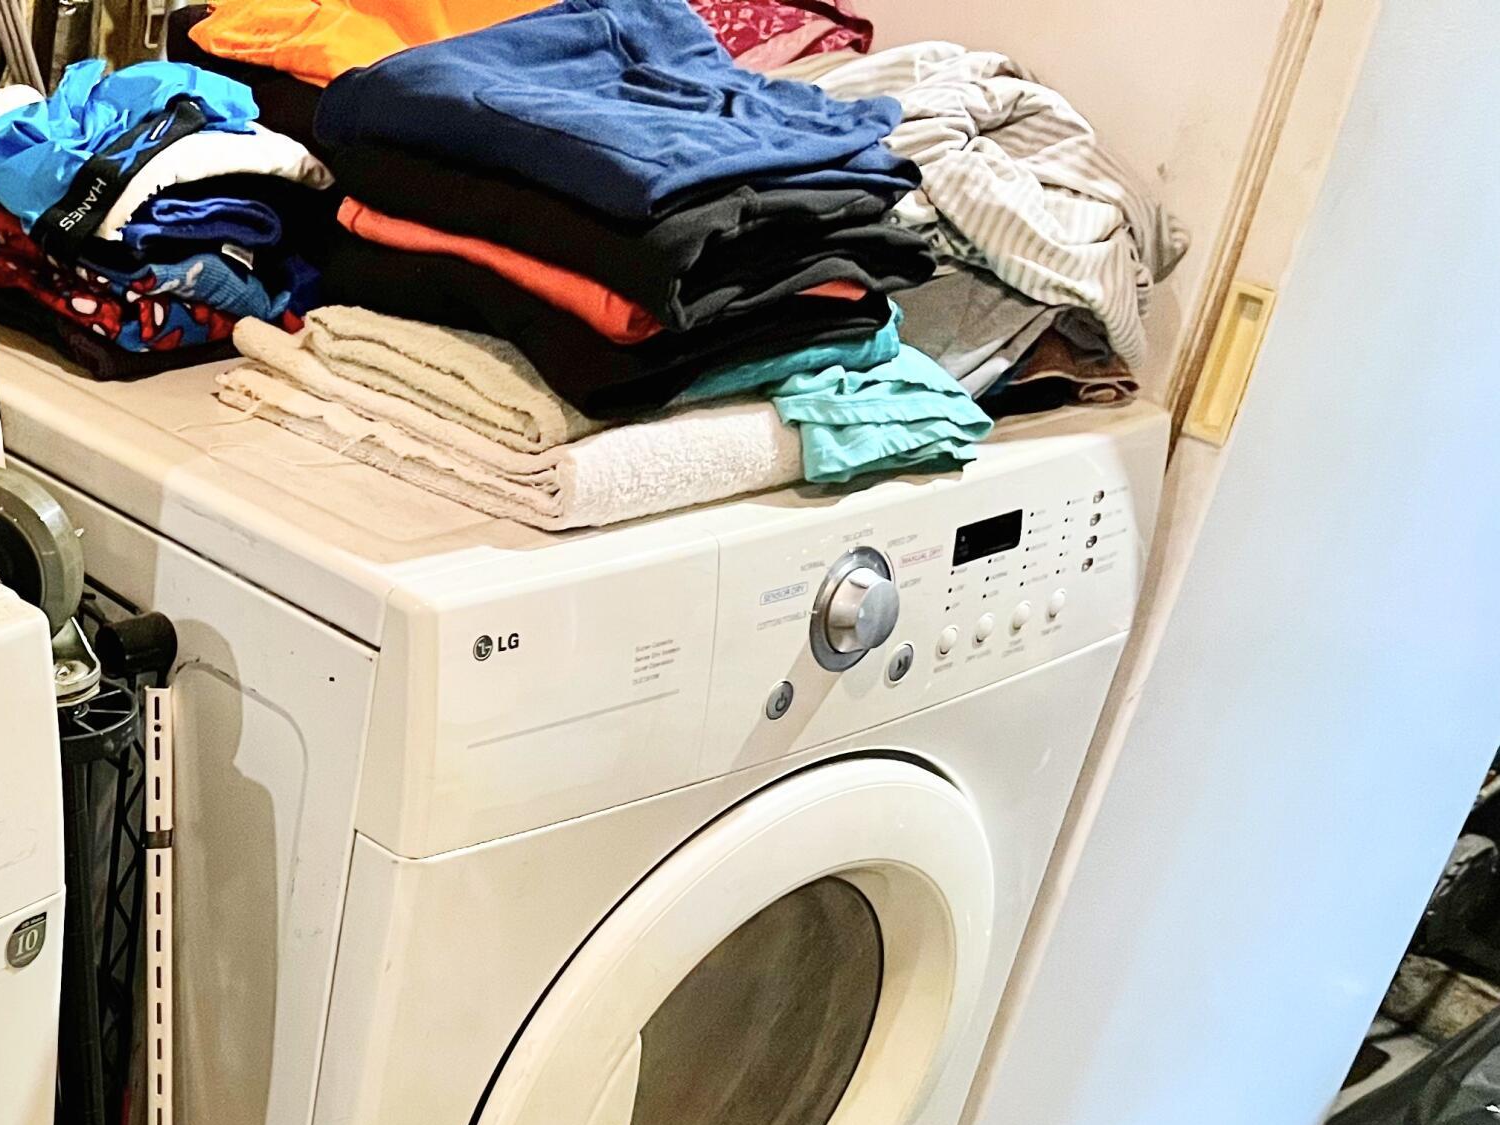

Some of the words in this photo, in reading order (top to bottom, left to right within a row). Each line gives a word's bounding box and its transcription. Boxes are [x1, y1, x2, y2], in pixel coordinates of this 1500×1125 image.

[59, 177, 107, 231] HANES
[497, 632, 520, 653] LG
[16, 929, 38, 957] 10
